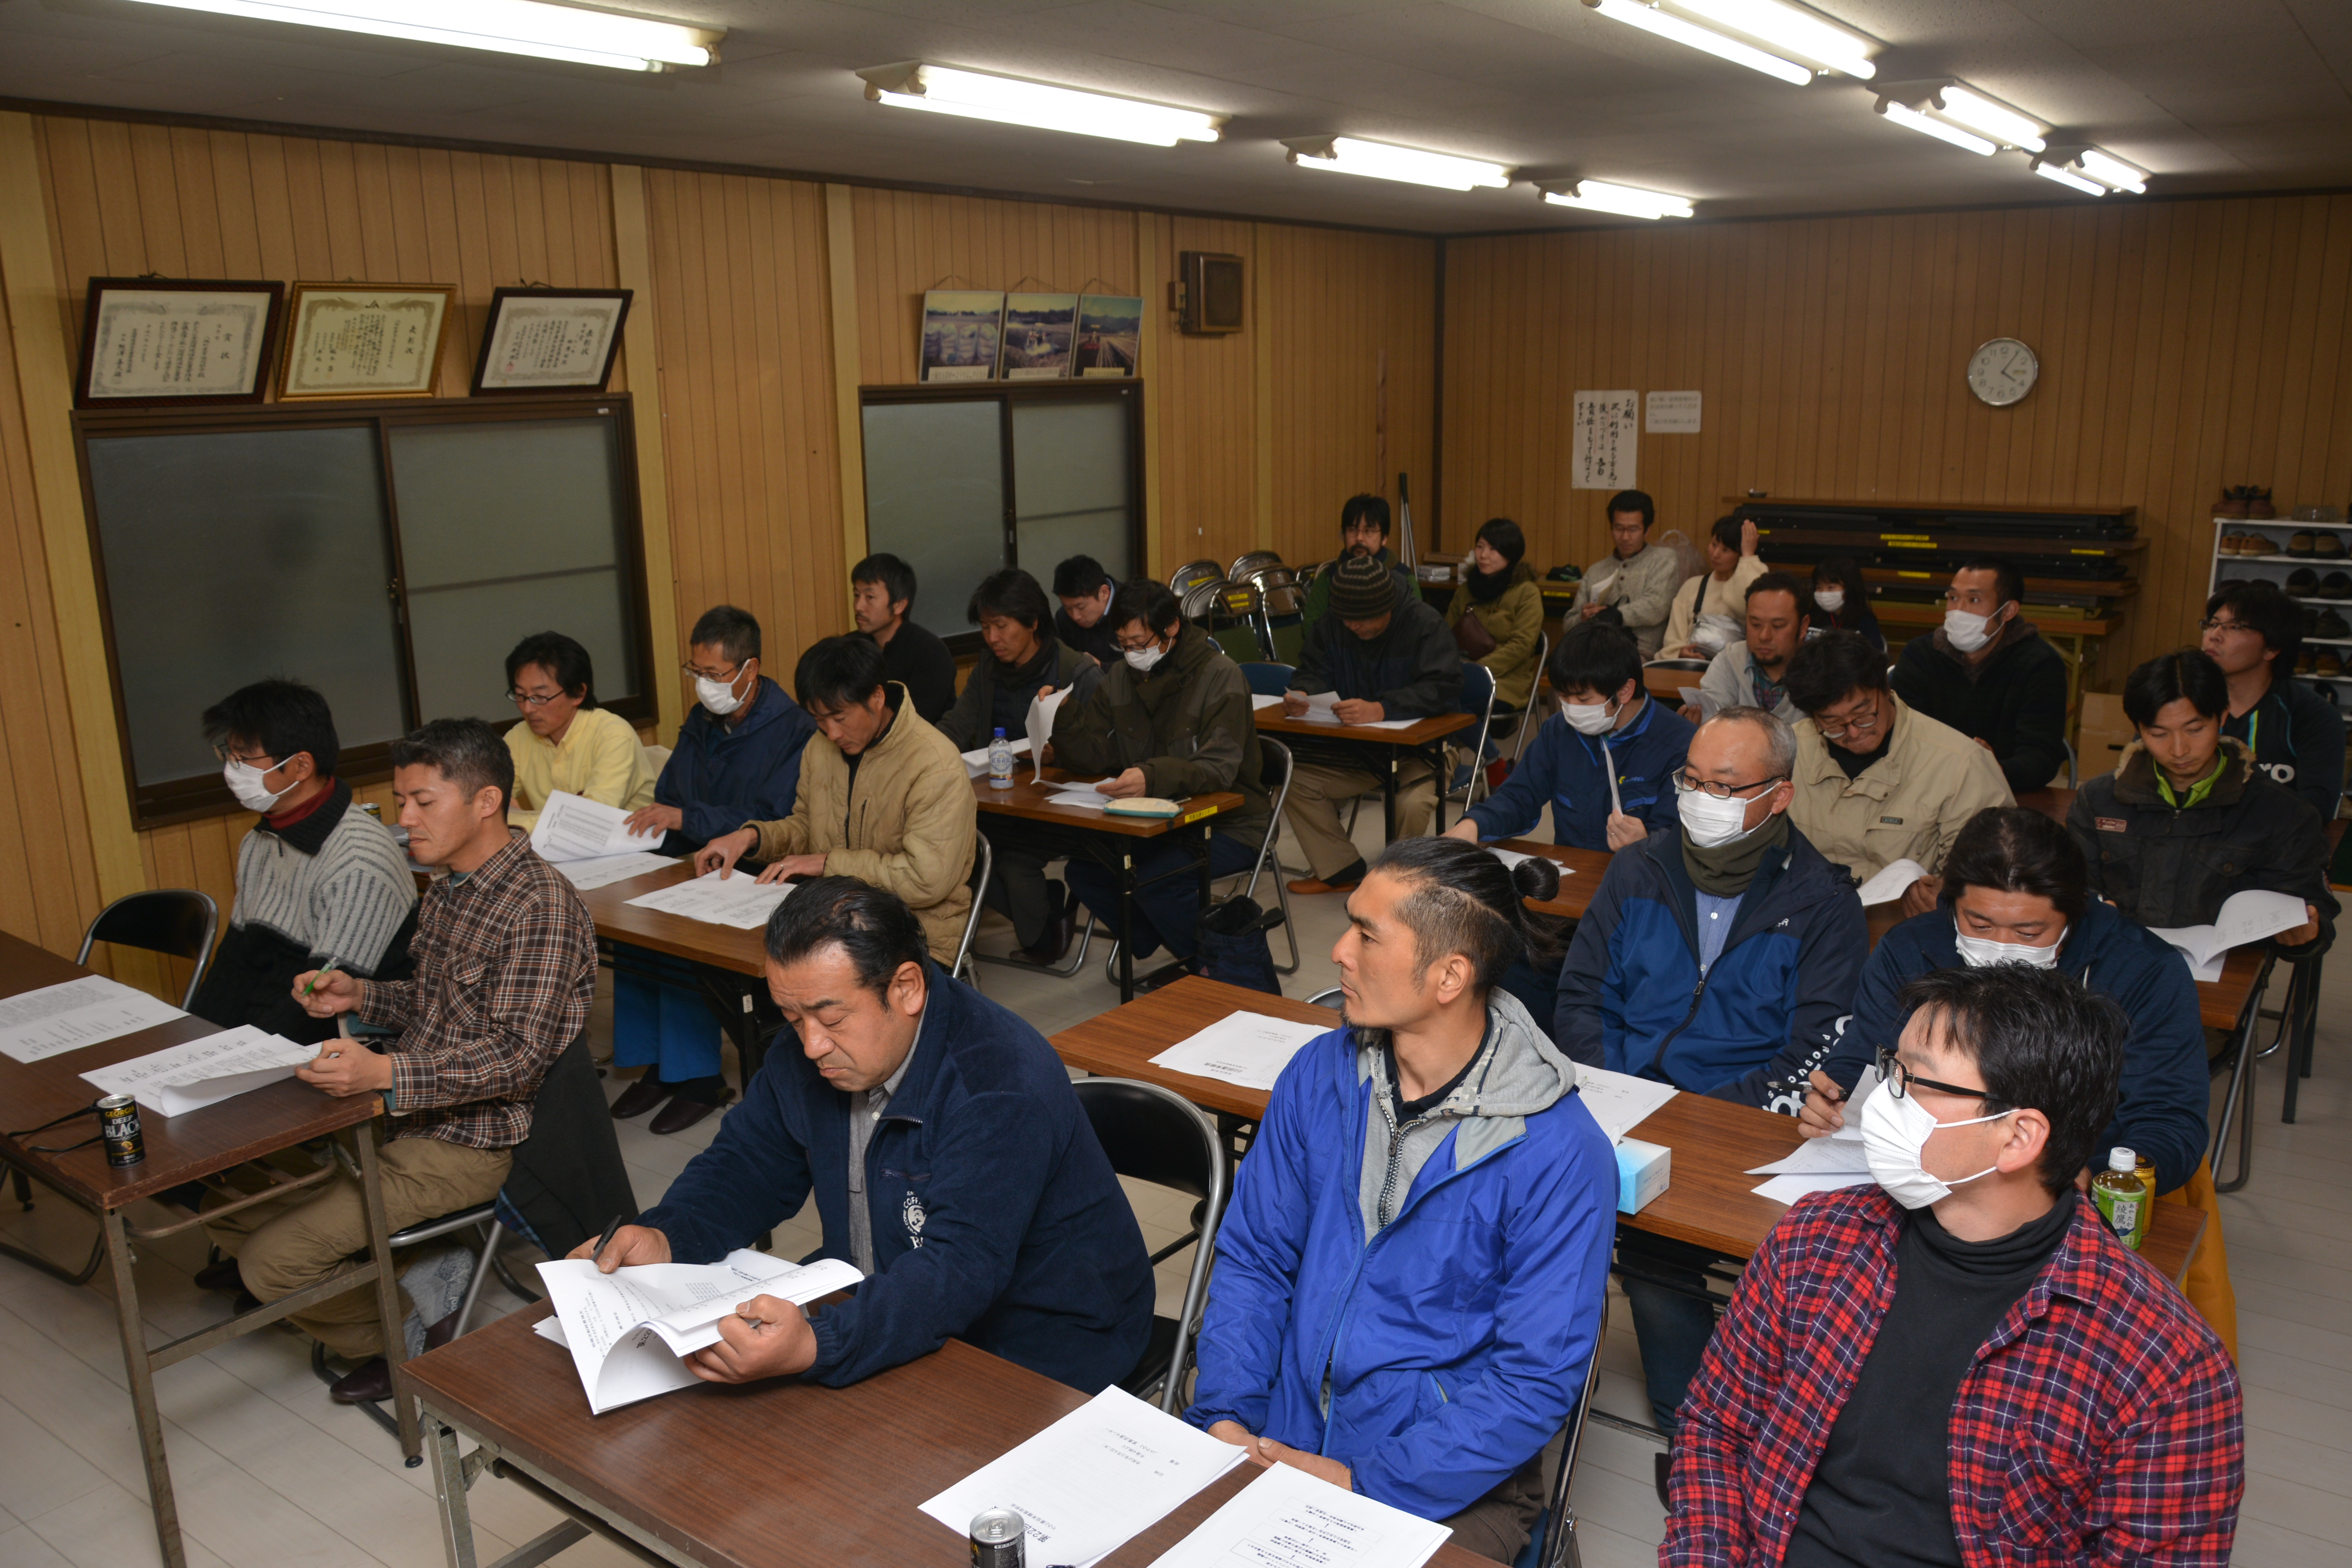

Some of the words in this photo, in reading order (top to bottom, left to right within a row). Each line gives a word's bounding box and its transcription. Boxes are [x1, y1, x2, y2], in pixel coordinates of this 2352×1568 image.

[2000, 346, 2009, 355] 12
[1998, 389, 2005, 398] 6
[1622, 398, 1635, 429] お願い
[1768, 1034, 1831, 1099] PRODUCS
[105, 1106, 135, 1117] GEORGIA
[104, 1118, 141, 1137] BLACK
[112, 1115, 133, 1125] DEEP
[904, 1197, 921, 1208] COFF
[2114, 1205, 2127, 1225] 綾鷹
[2126, 1203, 2134, 1227] あやたか
[1121, 1445, 1145, 1458] 午後4時より
[1140, 1444, 1157, 1454] JAやさと
[1011, 1503, 1057, 1530] やさと農協有機栽培部会
[1024, 1523, 1051, 1543] 第22回
